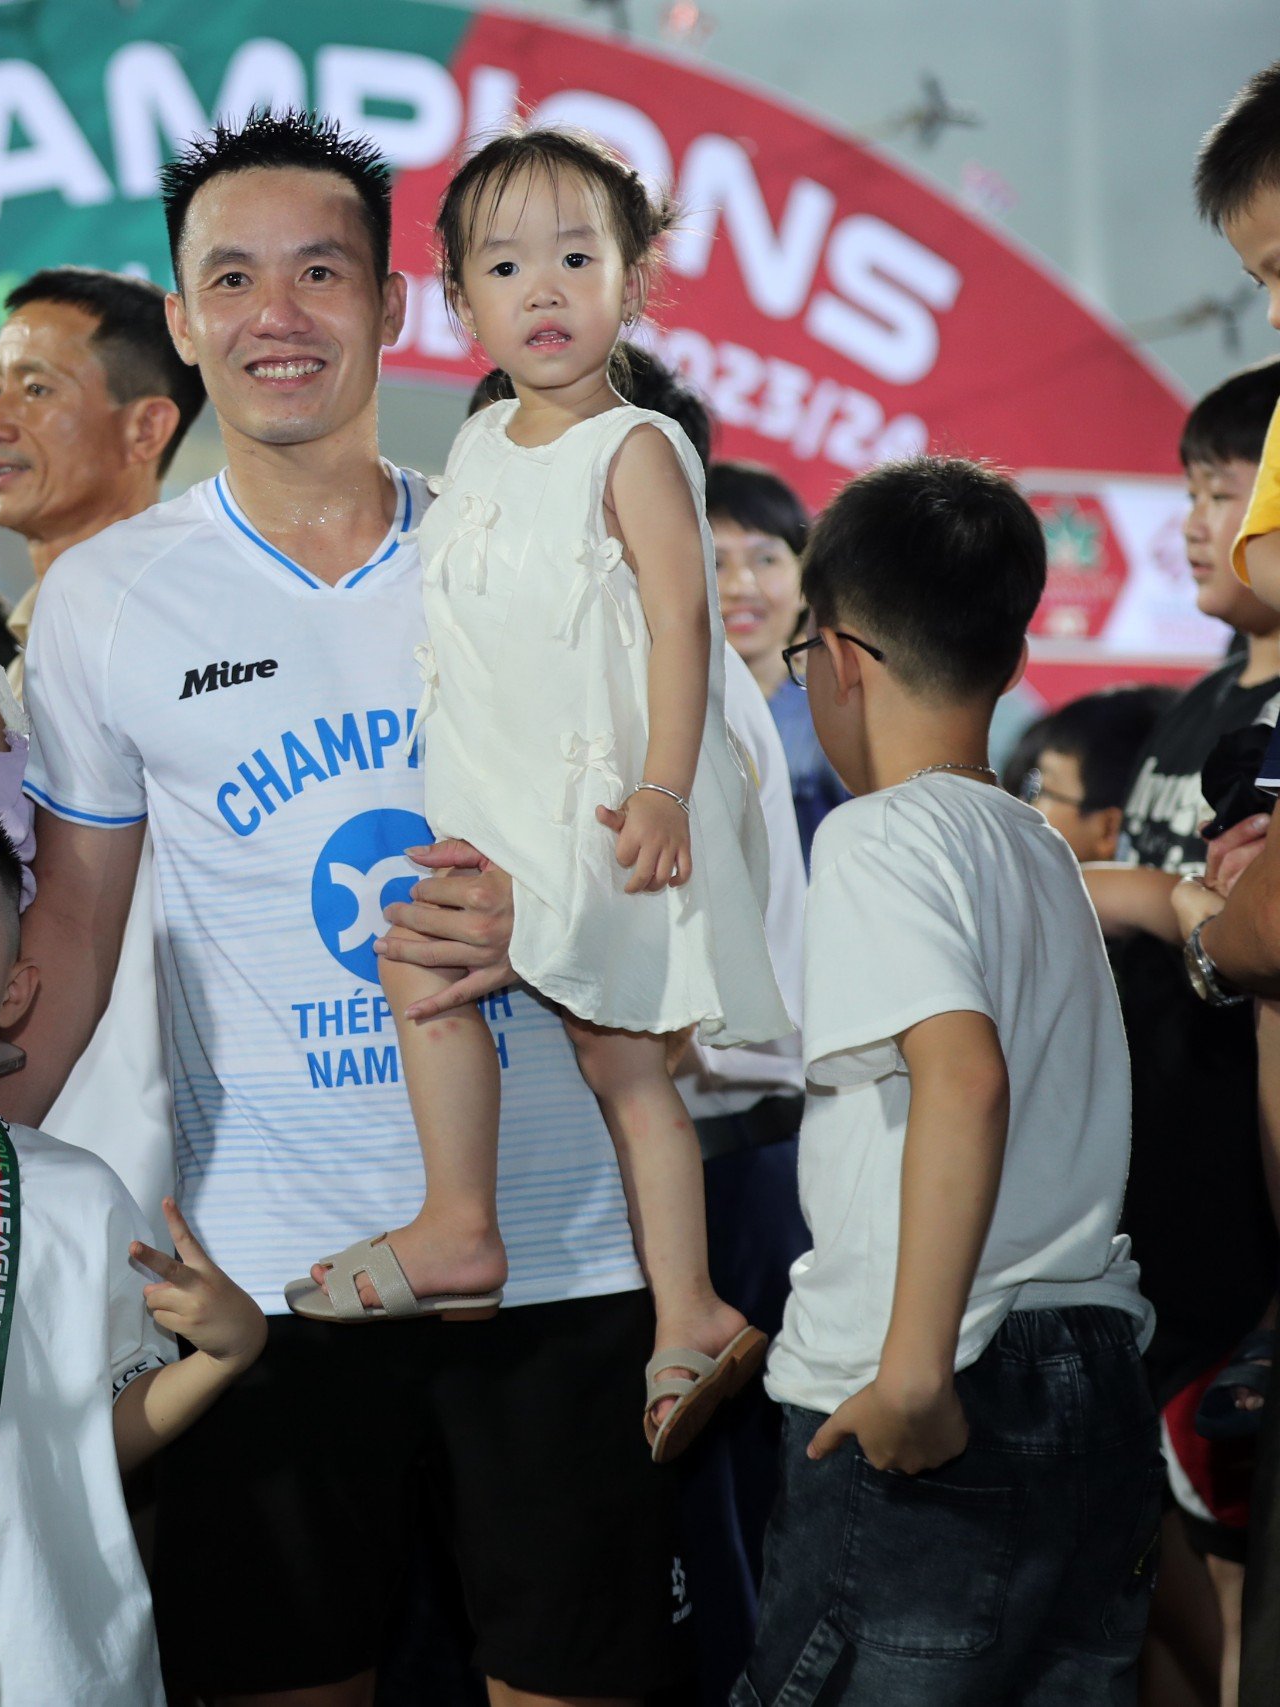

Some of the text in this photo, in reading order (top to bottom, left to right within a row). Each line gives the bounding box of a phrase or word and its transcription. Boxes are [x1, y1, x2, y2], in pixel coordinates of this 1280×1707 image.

[178, 657, 280, 701] Mitre
[215, 707, 419, 837] CHAMPI
[306, 1045, 399, 1089] NAM
